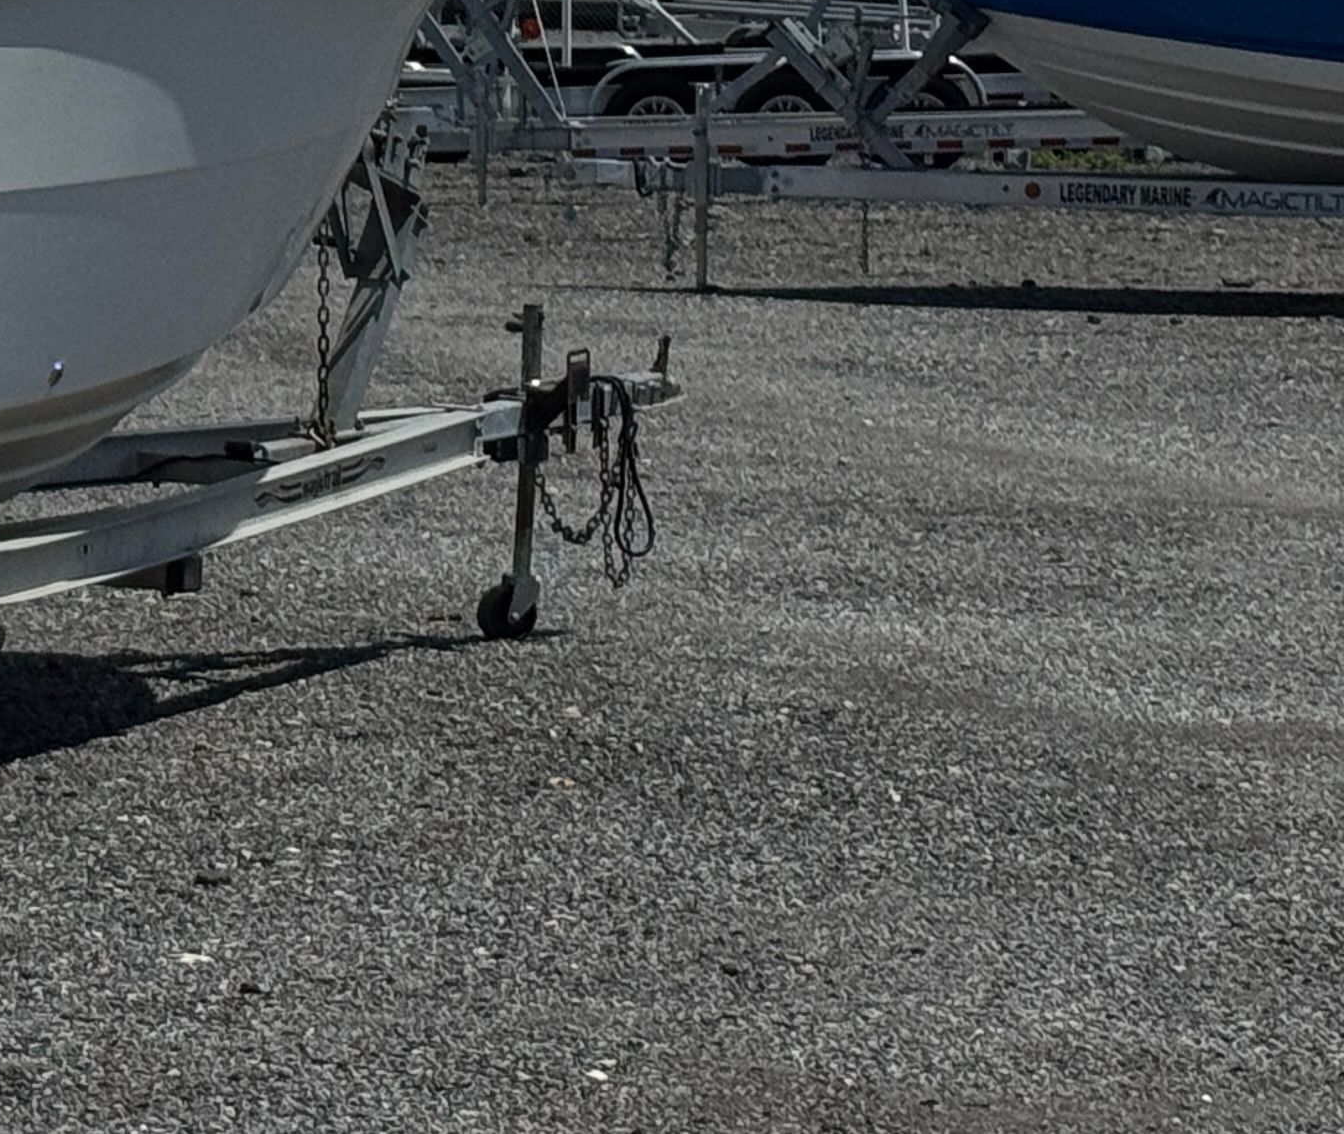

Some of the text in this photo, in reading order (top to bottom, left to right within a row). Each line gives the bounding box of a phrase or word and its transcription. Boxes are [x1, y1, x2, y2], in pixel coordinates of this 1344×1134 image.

[1059, 178, 1344, 213] LEGENDARY MARINE MAGICTILT
